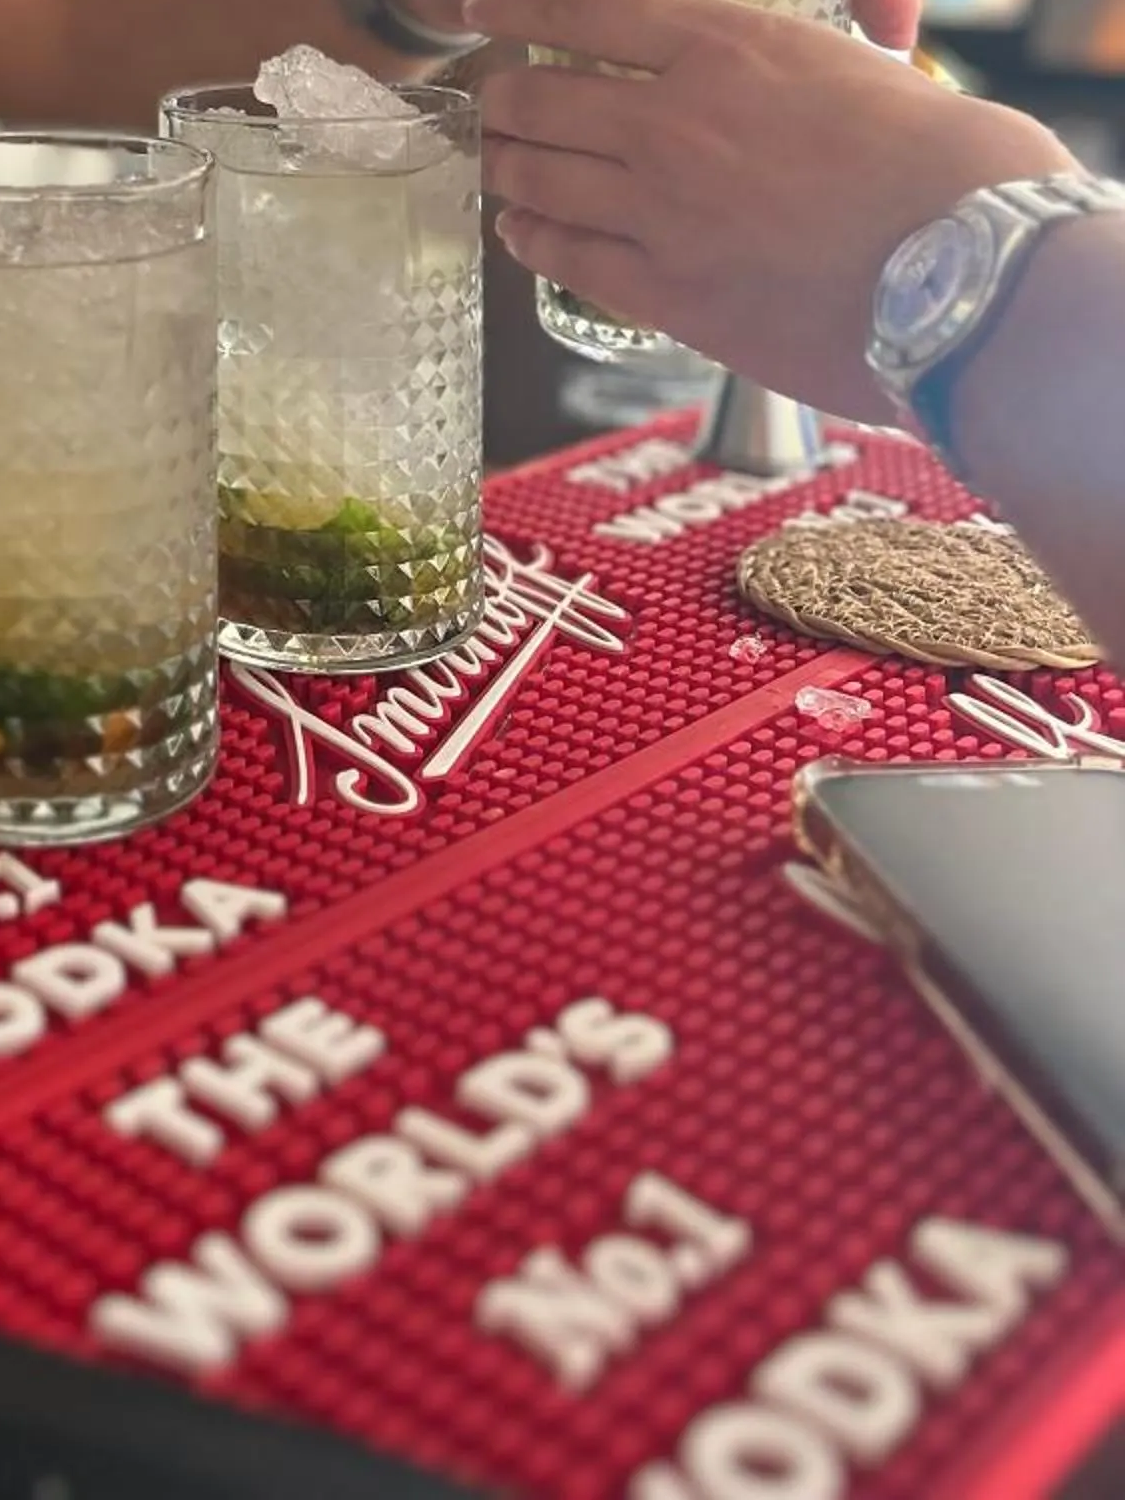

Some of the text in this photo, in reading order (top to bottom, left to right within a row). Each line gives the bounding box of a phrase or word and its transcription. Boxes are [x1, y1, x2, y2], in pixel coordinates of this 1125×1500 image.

[88, 995, 674, 1374] WORLD'S
[104, 995, 387, 1167] THE
[476, 1170, 753, 1397] No.1
